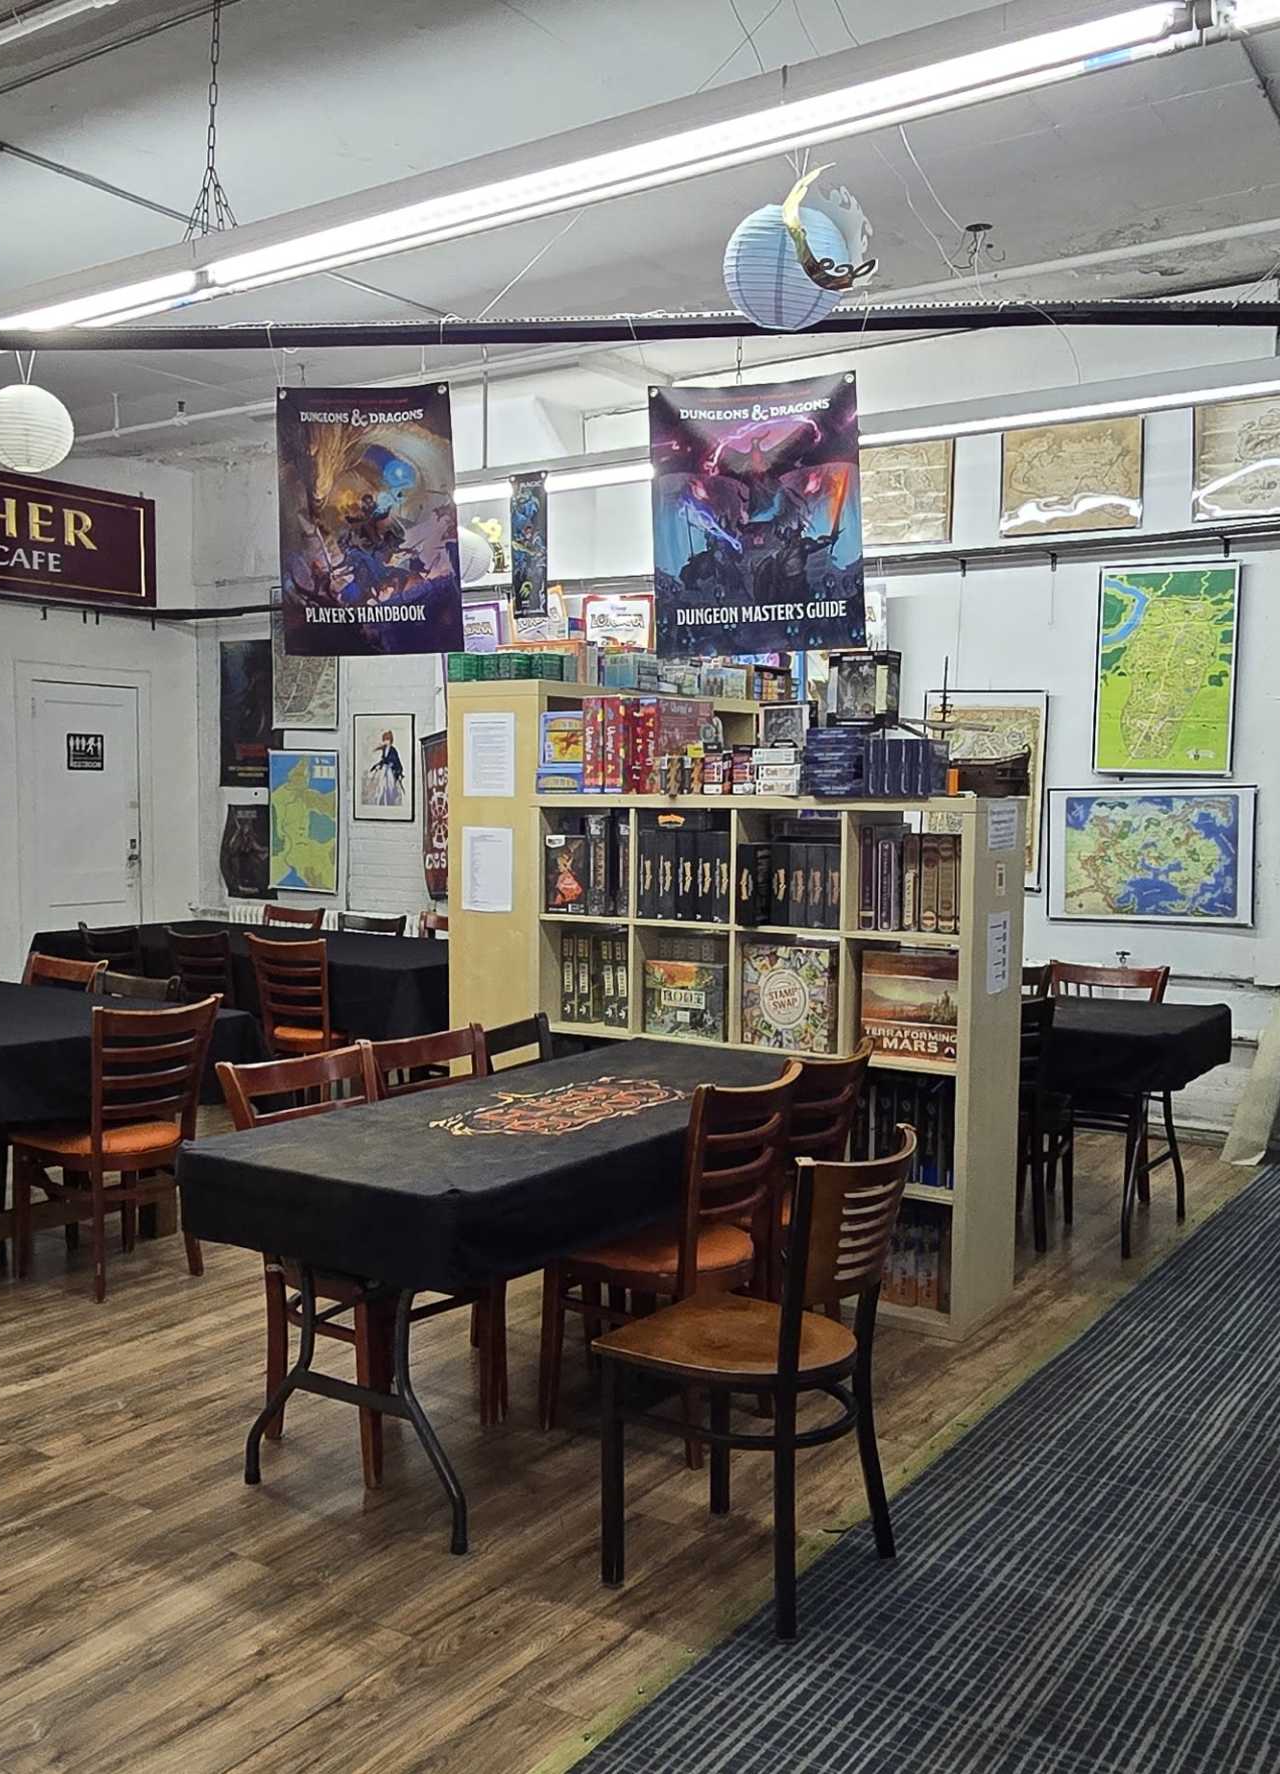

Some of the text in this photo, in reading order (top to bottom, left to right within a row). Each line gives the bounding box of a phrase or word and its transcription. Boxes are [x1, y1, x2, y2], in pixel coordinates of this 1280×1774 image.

[300, 408, 424, 427] DUNGEONS & DRAGONS
[680, 398, 830, 421] DUNGEONS & DRAGONS
[305, 605, 426, 623] PLAYER'S HANDBOOK
[676, 601, 847, 626] DUNGEON MASTER'S GUIDE
[769, 987, 800, 1000] STAMP
[772, 999, 799, 1011] SWAP
[865, 1027, 957, 1043] TERRAFORMING
[882, 1037, 939, 1054] MARS
